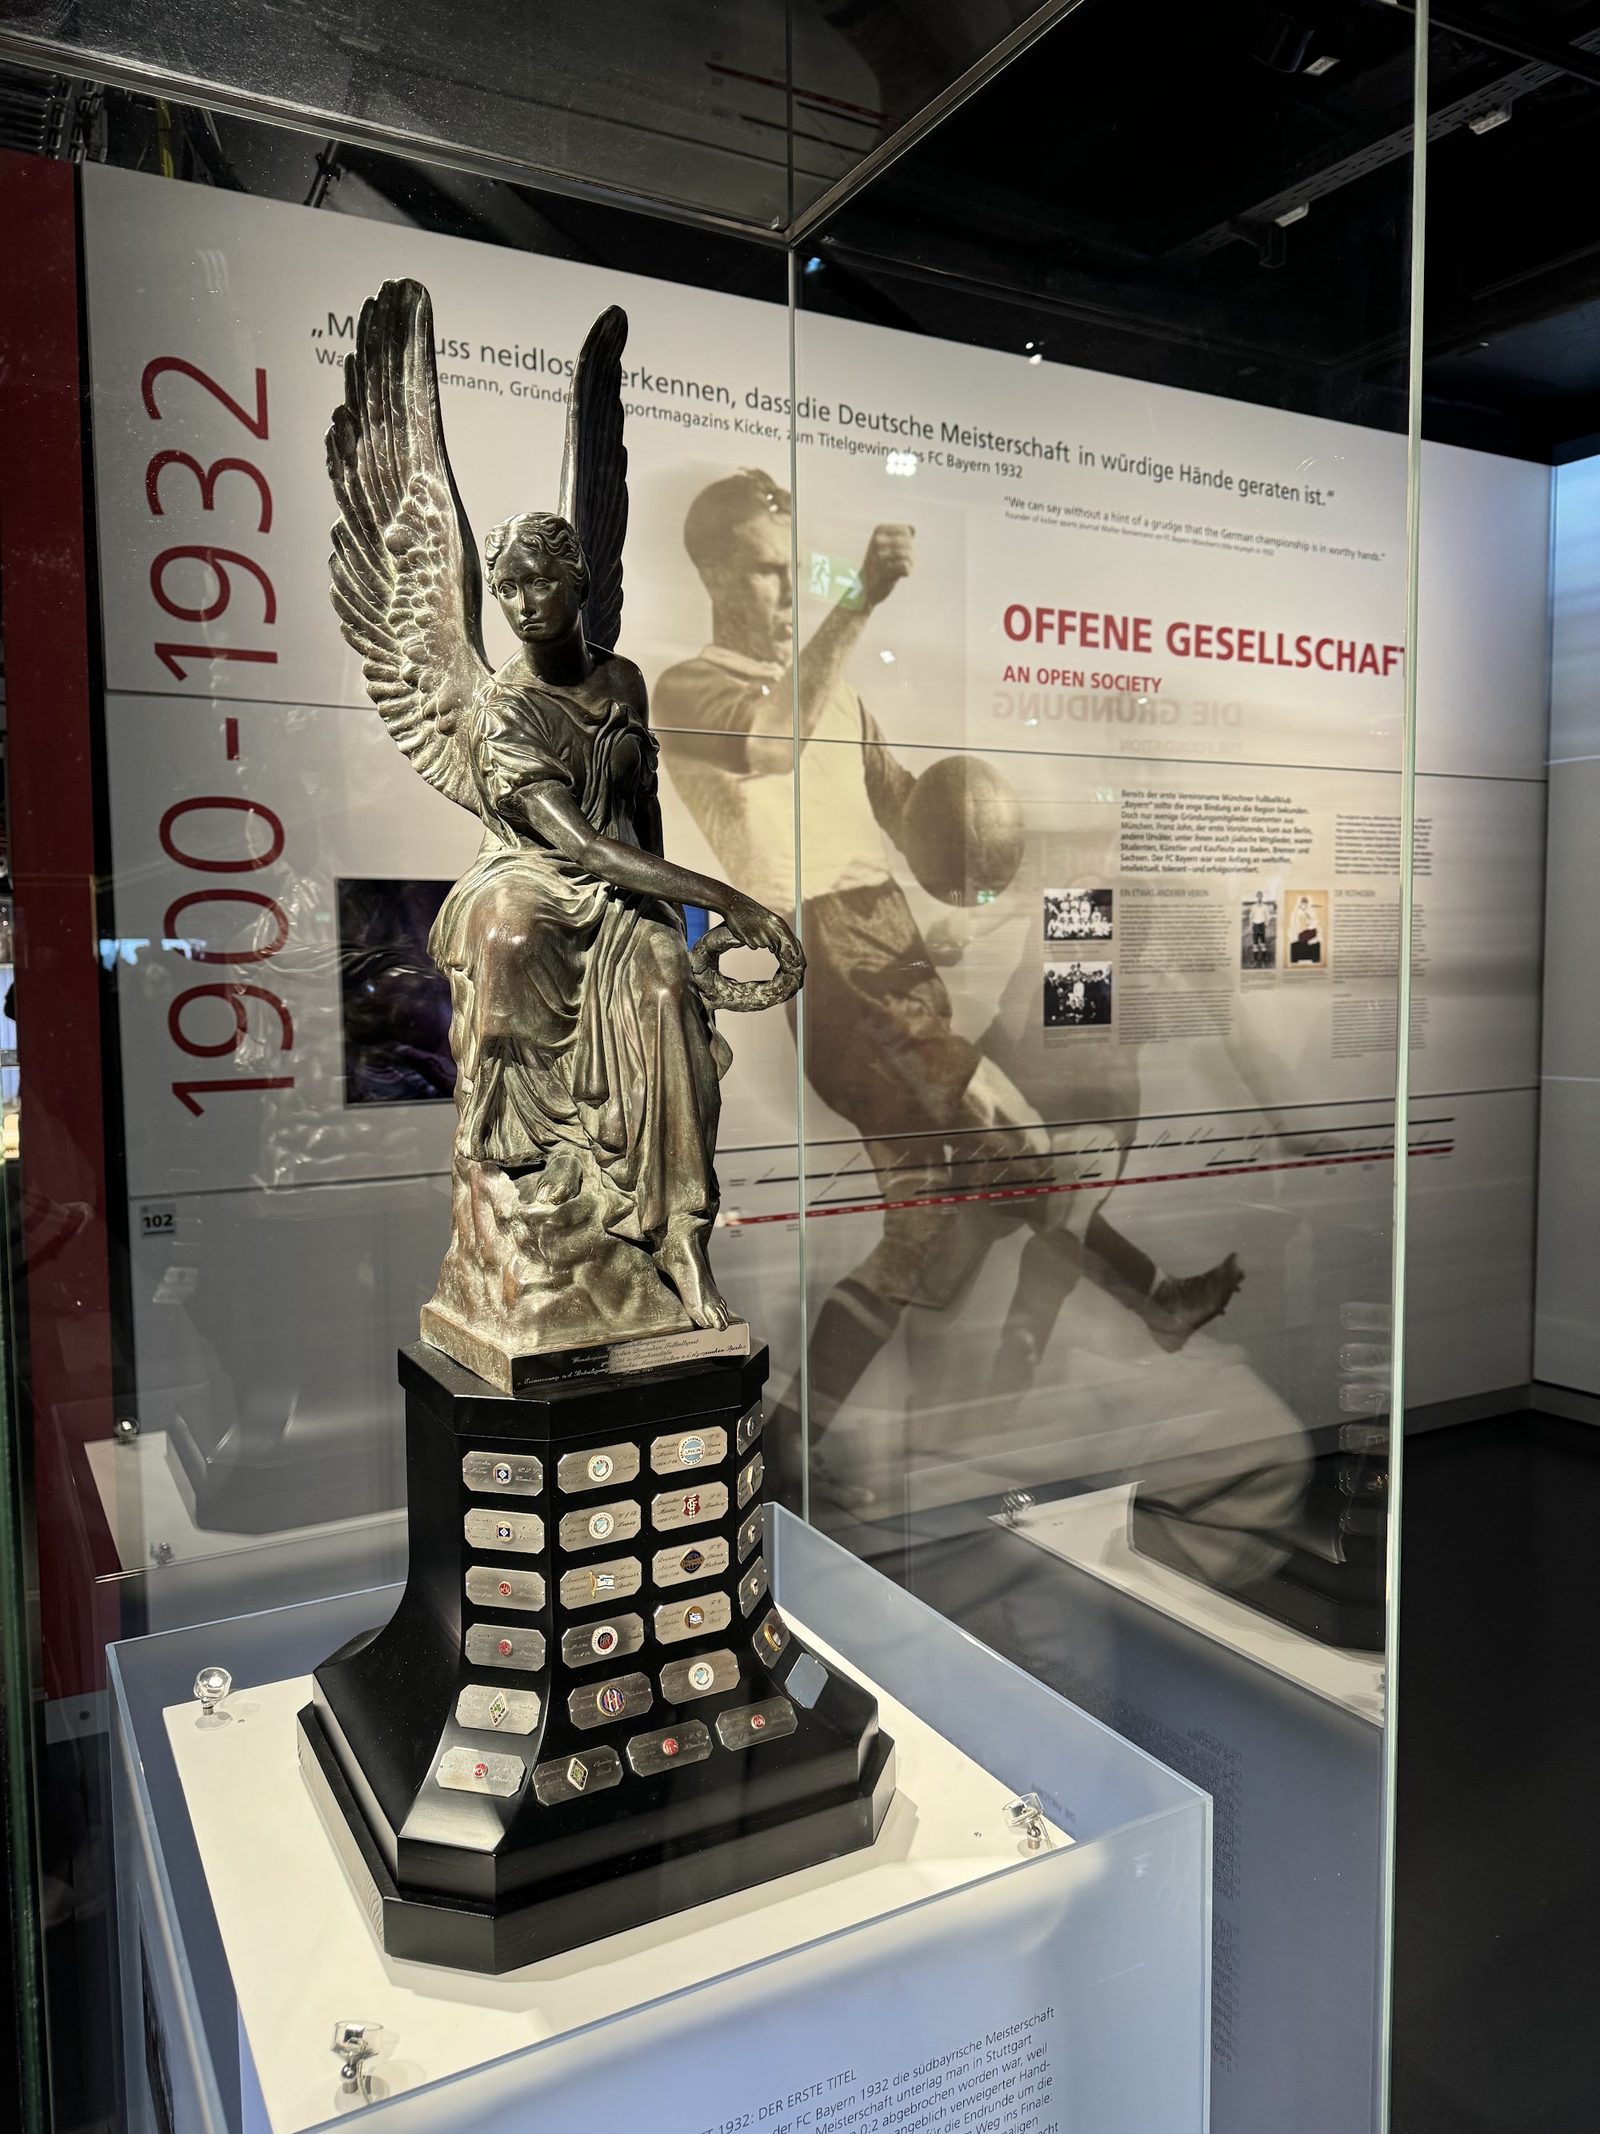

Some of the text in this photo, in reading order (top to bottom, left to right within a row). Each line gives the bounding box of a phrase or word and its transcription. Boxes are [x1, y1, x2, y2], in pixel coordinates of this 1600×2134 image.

[480, 344, 575, 377] neidlos
[621, 366, 737, 408] erkennen,
[745, 387, 791, 415] dass
[797, 397, 830, 422] die
[838, 404, 934, 440] Deutsche
[941, 422, 1070, 463] Meisterschaft
[1077, 445, 1095, 467] in
[1101, 453, 1174, 483] würdige
[1179, 463, 1233, 490] Hände
[1238, 478, 1300, 502] geraten
[625, 402, 730, 431] portmagazins
[734, 419, 782, 441] Kicker,
[928, 451, 944, 466] FC
[946, 453, 991, 474] Bayern
[995, 462, 1023, 479] 1932
[1003, 604, 1405, 676] OFFENE GESELLSCHAF
[1003, 665, 1162, 693] AN OPEN SOCIETY
[143, 1214, 173, 1228] 102
[719, 2069, 857, 2134] 1932: DER ERSTE TITEL
[796, 2112, 812, 2129] FC
[816, 2095, 856, 2121] Bayern
[861, 2078, 888, 2100] 1932
[892, 2071, 910, 2086] die
[913, 2041, 983, 2078] südbayrische
[985, 2006, 1055, 2046] Meisterschaft
[815, 2034, 1033, 2134] Meisterschaft unterlag man in Stuttgart
[882, 2086, 955, 2126] abgebrochen
[957, 2066, 999, 2093] worden
[1002, 2056, 1023, 2074] war,
[1026, 2042, 1048, 2062] weil
[894, 2060, 1051, 2134] angeblich verweigerter Hand-
[944, 2118, 961, 2134] die
[964, 2092, 1015, 2125] Endrunde
[1018, 2083, 1034, 2099] um
[1037, 2075, 1053, 2090] die
[976, 2093, 1053, 2134] Weg ins Finale:
